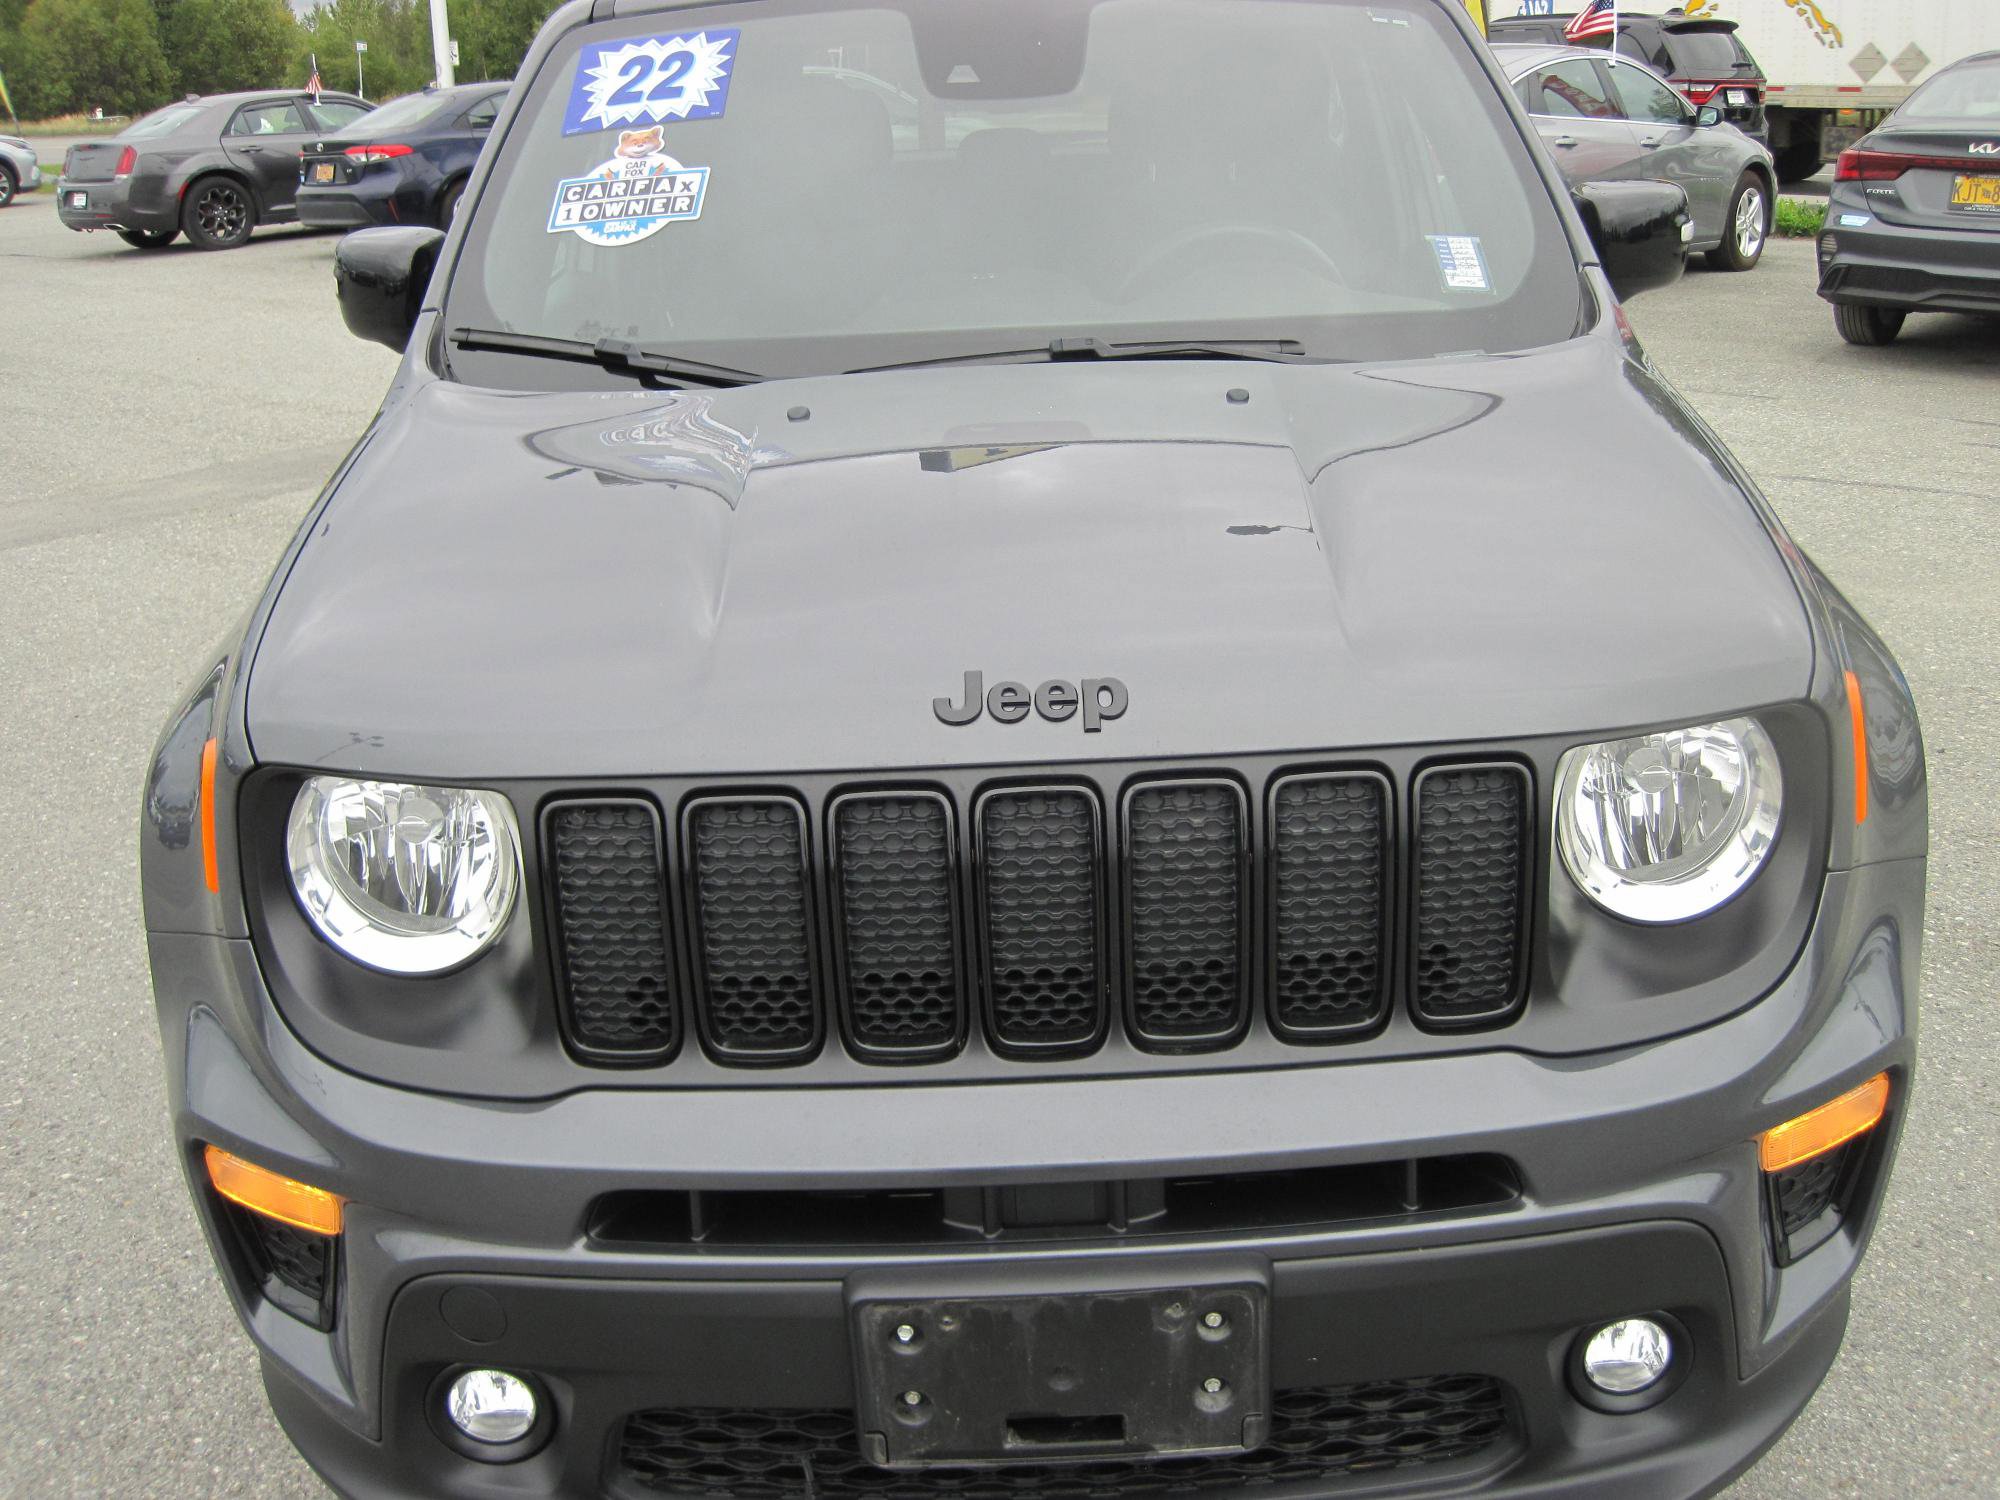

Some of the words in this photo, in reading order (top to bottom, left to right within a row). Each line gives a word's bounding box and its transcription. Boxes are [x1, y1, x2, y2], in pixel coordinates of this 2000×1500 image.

[606, 50, 696, 107] 22
[624, 169, 644, 177] FOX
[625, 160, 647, 170] CAR
[567, 177, 694, 201] CARFAX
[1952, 182, 1983, 202] KJT
[562, 207, 575, 222] 1
[583, 197, 691, 220] OWNER
[932, 670, 1129, 733] Jeep
